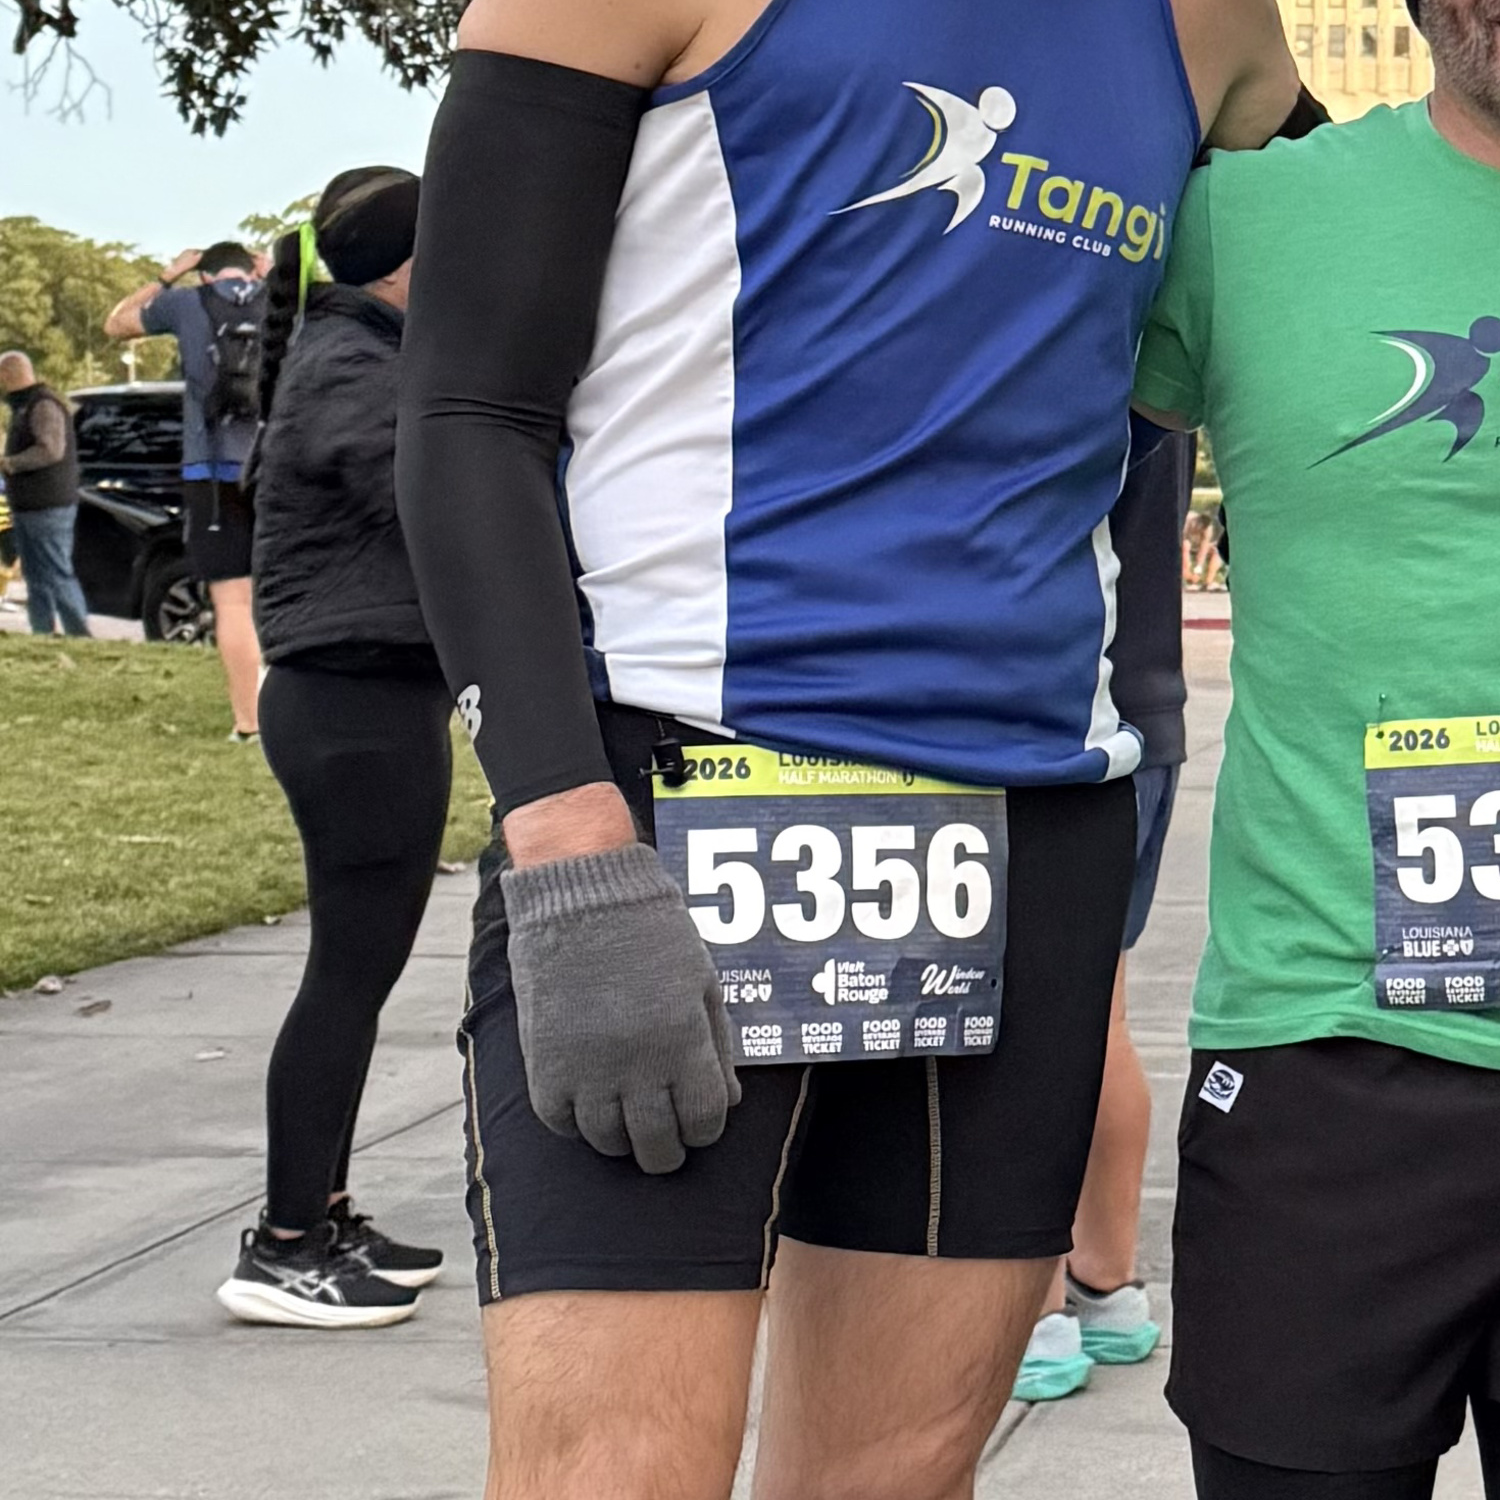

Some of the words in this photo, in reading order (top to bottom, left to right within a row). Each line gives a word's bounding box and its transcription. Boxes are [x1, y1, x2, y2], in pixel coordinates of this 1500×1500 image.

[1001, 152, 1166, 263] Tangi
[988, 214, 1067, 245] RUNNING
[1071, 235, 1112, 258] CLUB
[1388, 728, 1450, 751] 2026
[778, 752, 864, 767] LOUIS
[683, 757, 751, 781] 2026
[778, 770, 816, 785] HALF
[818, 769, 898, 785] MARATHON
[687, 823, 992, 945] 5356
[1402, 926, 1473, 940] LOUISIANA
[1403, 939, 1441, 957] BLUE
[837, 961, 865, 974] Visit
[716, 968, 772, 984] UISIANA
[837, 973, 886, 988] Baton
[1445, 976, 1485, 988] FOOD
[1386, 978, 1426, 990] FOOD
[837, 987, 889, 1004] Rouge
[801, 1022, 843, 1036] FOOD
[862, 1019, 901, 1033] FOOD
[914, 1017, 947, 1030] FOOD
[964, 1016, 994, 1029] FOOD
[742, 1025, 782, 1039] FOOD
